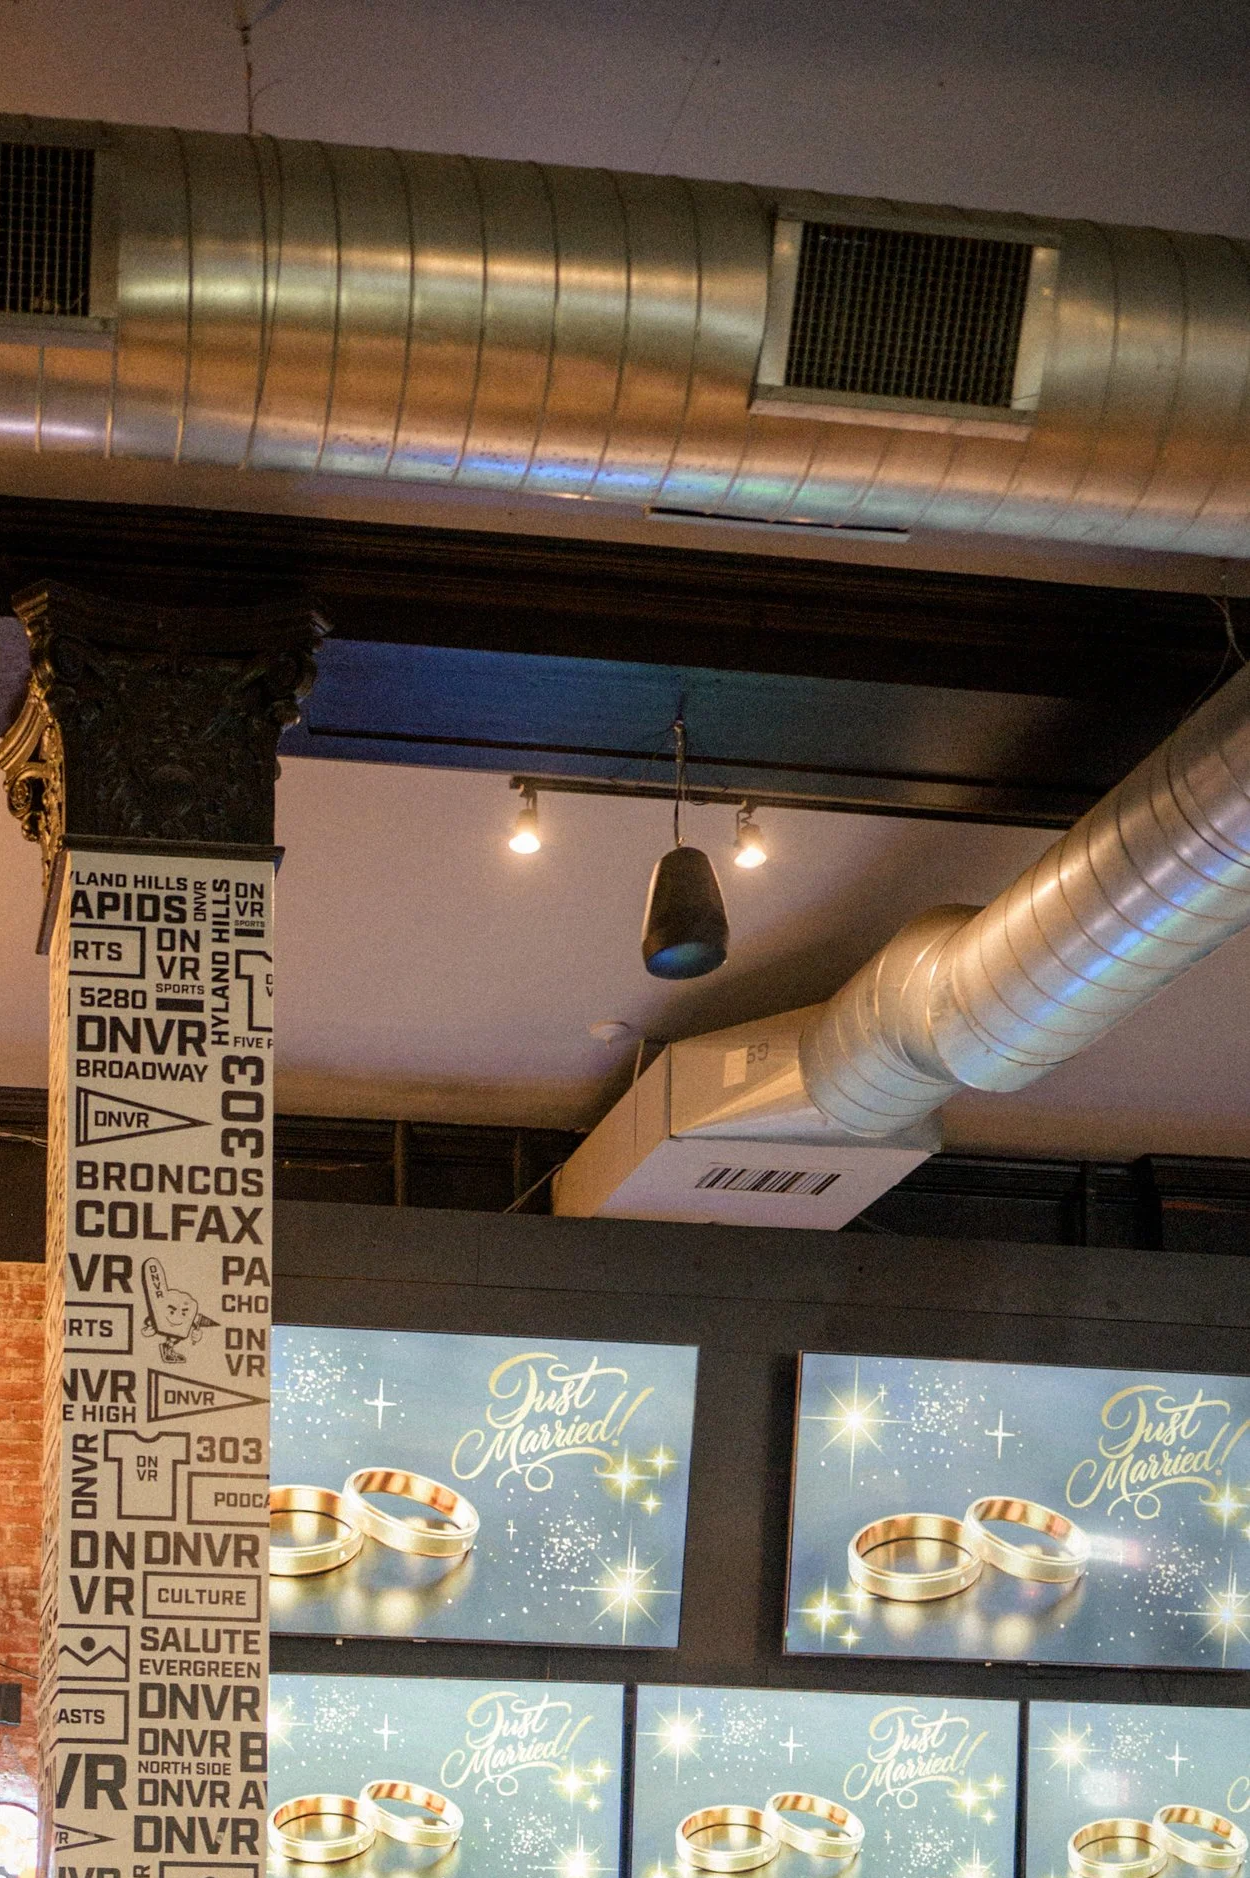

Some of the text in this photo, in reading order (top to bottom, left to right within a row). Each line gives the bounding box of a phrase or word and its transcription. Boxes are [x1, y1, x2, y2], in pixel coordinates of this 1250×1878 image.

[70, 871, 188, 892] LAND HILLS
[235, 882, 264, 899] DN
[70, 890, 187, 924] APIDS
[193, 880, 207, 922] DNVR
[211, 879, 230, 943] HILLS
[235, 901, 264, 918] VR
[234, 920, 265, 928] SPORTS
[69, 940, 122, 961] RTS
[156, 928, 200, 953] DN
[156, 955, 200, 980] VR
[80, 987, 147, 1010] 5280
[156, 983, 205, 995] SPORTS
[211, 951, 230, 1046] HYLAND
[76, 1015, 208, 1057] DNVR
[233, 1036, 263, 1049] FIVE
[76, 1059, 208, 1082] BROADWAY
[94, 1111, 149, 1129] DNVR
[221, 1055, 264, 1158] 303
[76, 1160, 263, 1197] BRONCOS
[75, 1199, 263, 1245] COLFAX
[68, 1253, 133, 1293] VR
[149, 1264, 163, 1299] DNVR
[222, 1294, 269, 1314] CHO
[225, 1327, 266, 1351] DN
[225, 1354, 266, 1378] VR
[164, 1390, 215, 1406] DNVR
[486, 1352, 628, 1428] Just
[82, 1405, 136, 1423] HIGH
[1099, 1385, 1230, 1456] Just
[137, 1455, 158, 1468] DN
[196, 1436, 262, 1464] 303
[71, 1433, 98, 1520] DNVR
[137, 1469, 158, 1482] VR
[71, 1530, 135, 1570] DN
[144, 1531, 260, 1568] DNVR
[70, 1575, 134, 1616] VR
[158, 1587, 246, 1606] CULTURE
[140, 1626, 260, 1655] SALUTE
[139, 1659, 260, 1678] EVERGREEN
[139, 1682, 260, 1722] DNVR
[57, 1709, 105, 1724] ASTS
[466, 1691, 572, 1750] Just
[138, 1728, 231, 1758] DNVR
[868, 1707, 970, 1764] Just
[138, 1761, 231, 1776] NORTH SIDE
[138, 1778, 267, 1810] DNVR A
[134, 1815, 259, 1855] DNVR
